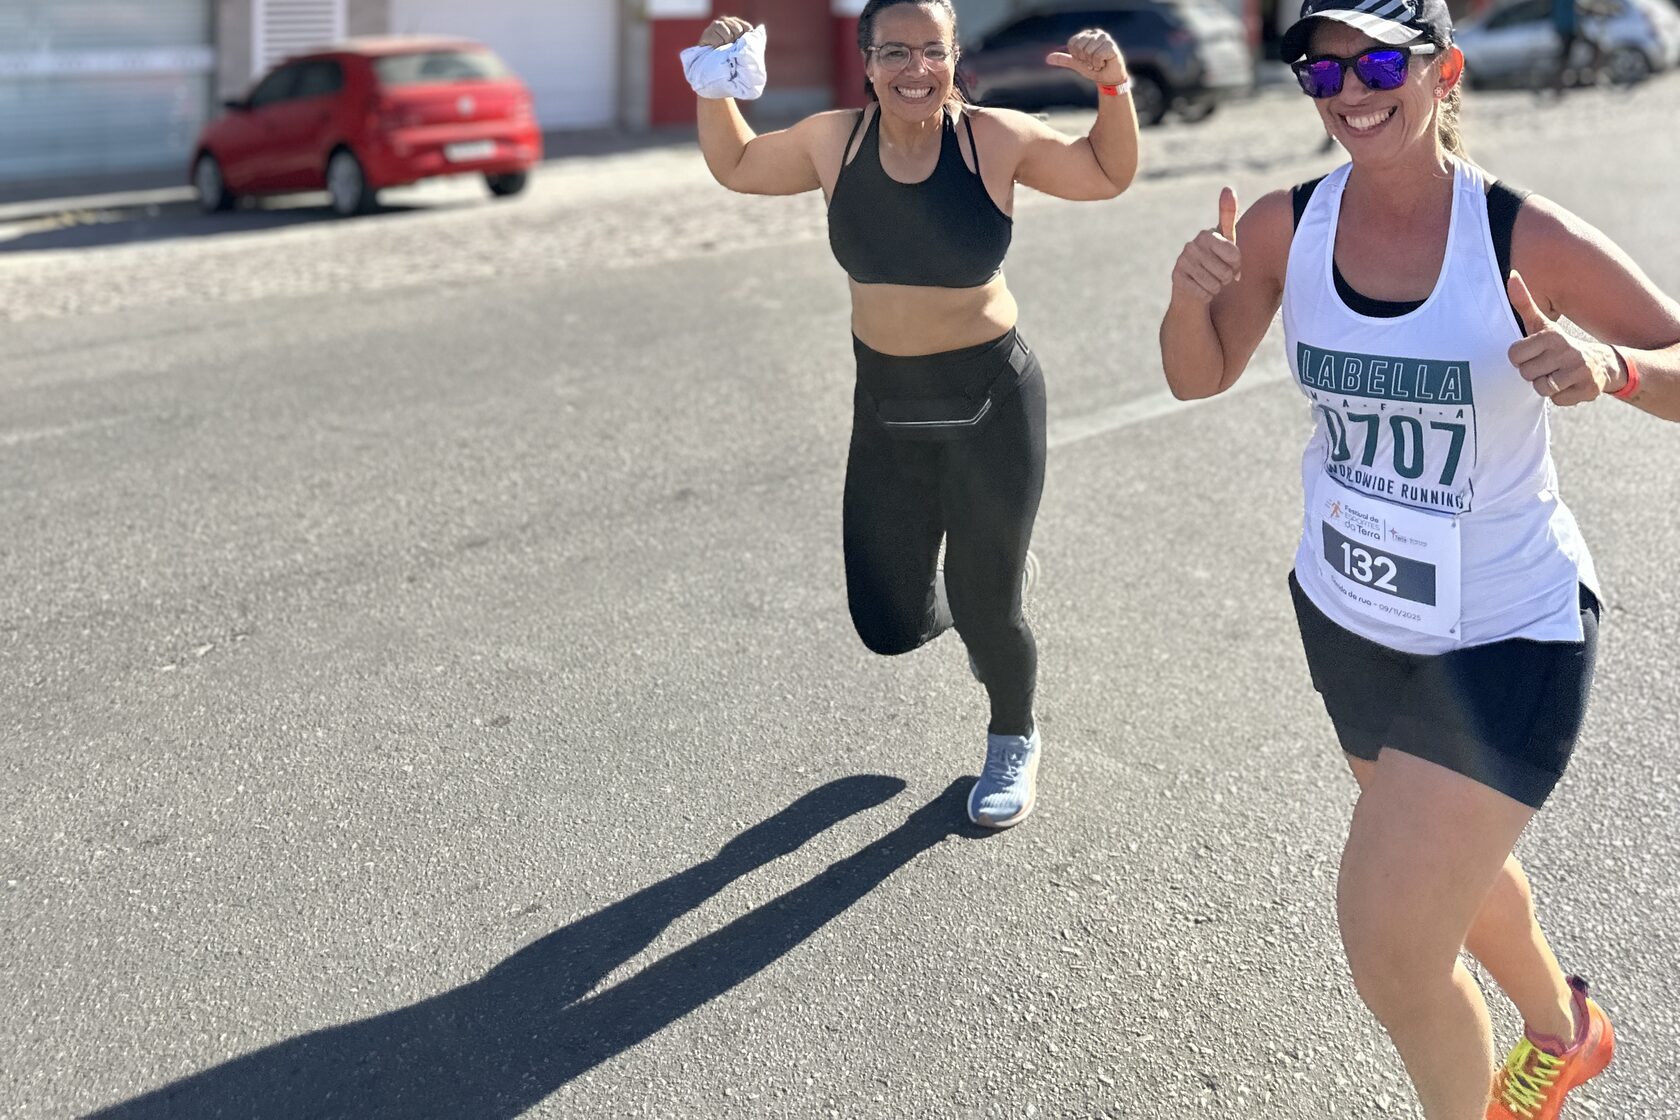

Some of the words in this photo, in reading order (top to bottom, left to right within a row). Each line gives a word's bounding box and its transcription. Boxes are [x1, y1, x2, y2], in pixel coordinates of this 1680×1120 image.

[1301, 349, 1462, 401] LABELLA
[1401, 483, 1464, 510] RUNNING
[1344, 521, 1357, 533] da
[1356, 524, 1381, 541] Terra
[1340, 541, 1398, 593] 132
[1358, 596, 1373, 607] rua
